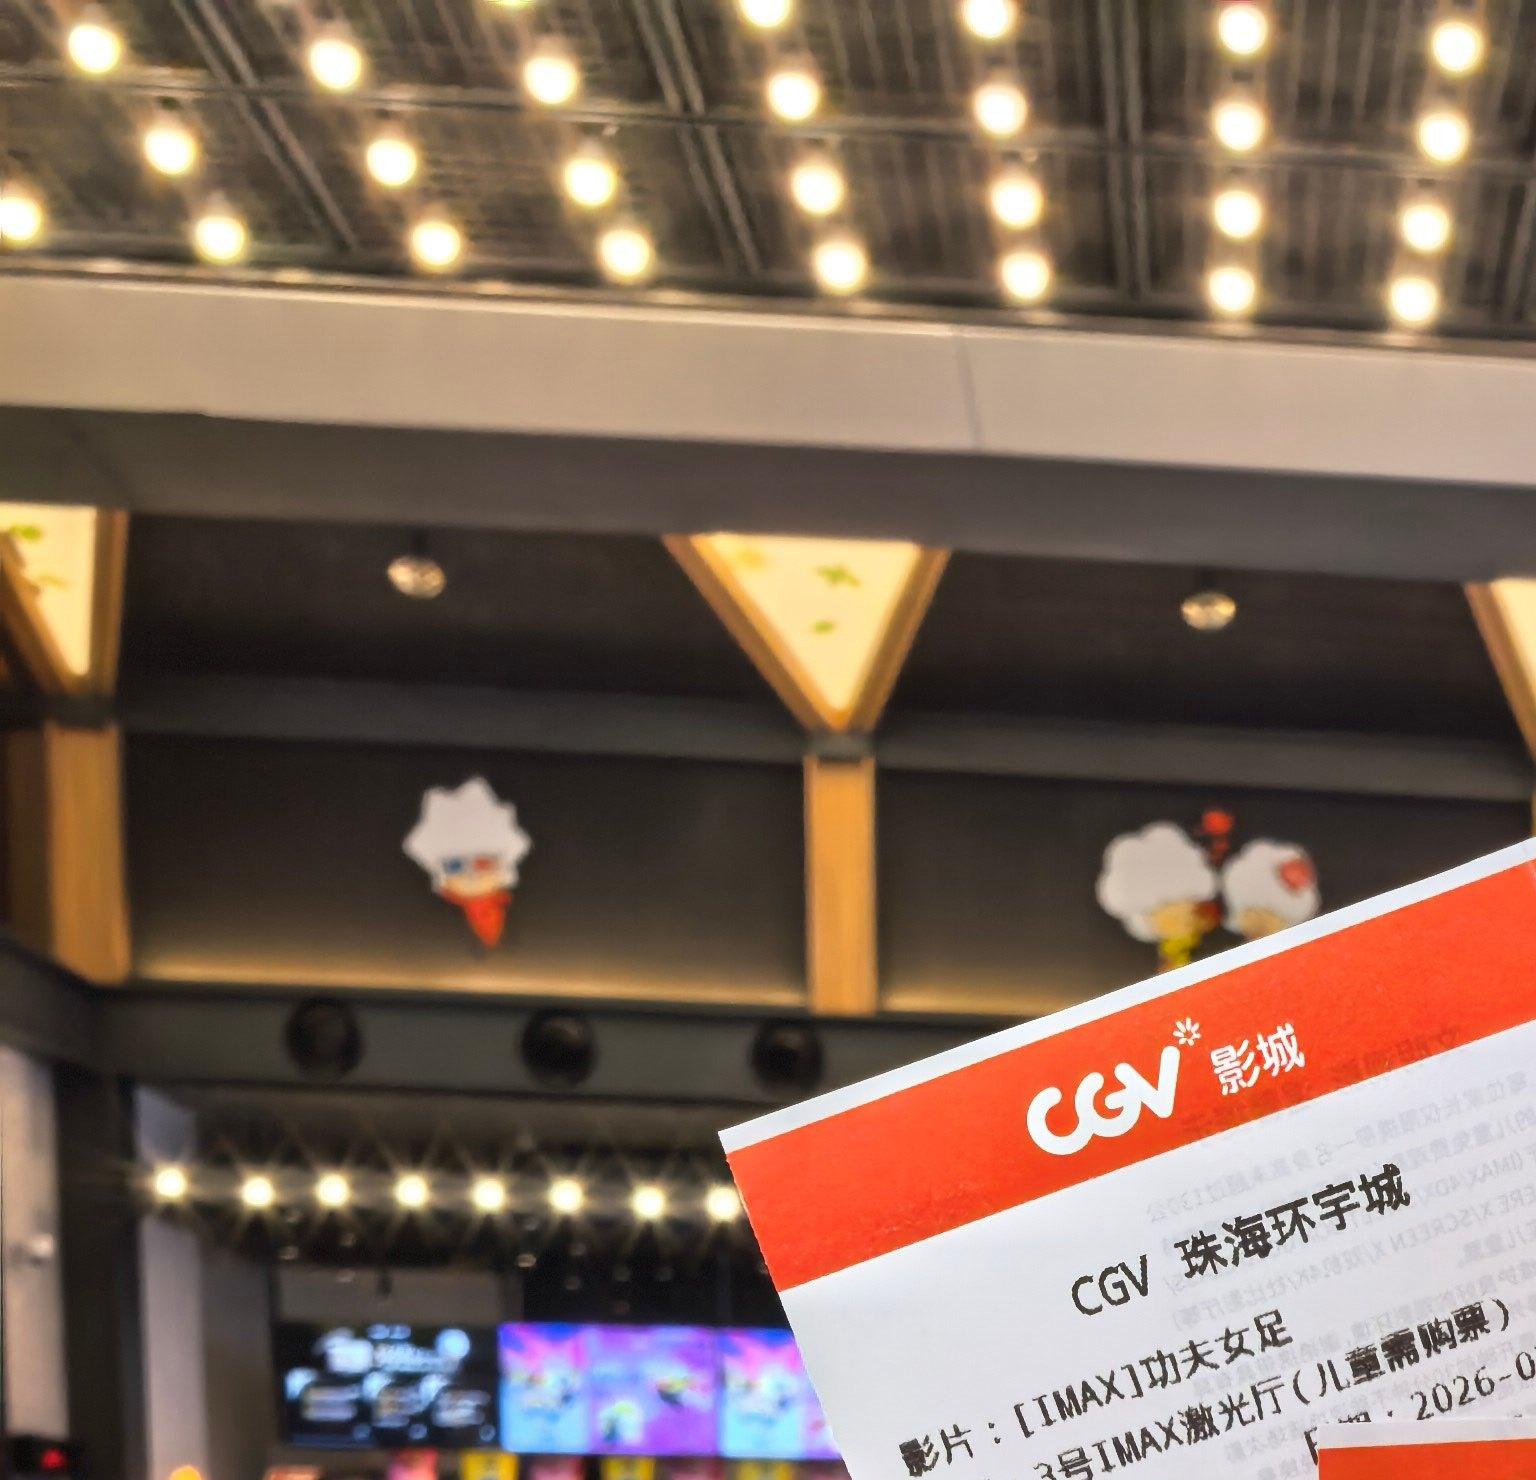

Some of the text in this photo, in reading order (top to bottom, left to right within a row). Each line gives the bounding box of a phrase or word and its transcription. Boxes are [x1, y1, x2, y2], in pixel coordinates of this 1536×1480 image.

[1026, 1023, 1306, 1156] CGV 影城
[1071, 1163, 1411, 1316] CGV 珠海环宇城
[898, 1309, 1293, 1478] 影片：[IMAX]功夫女足
